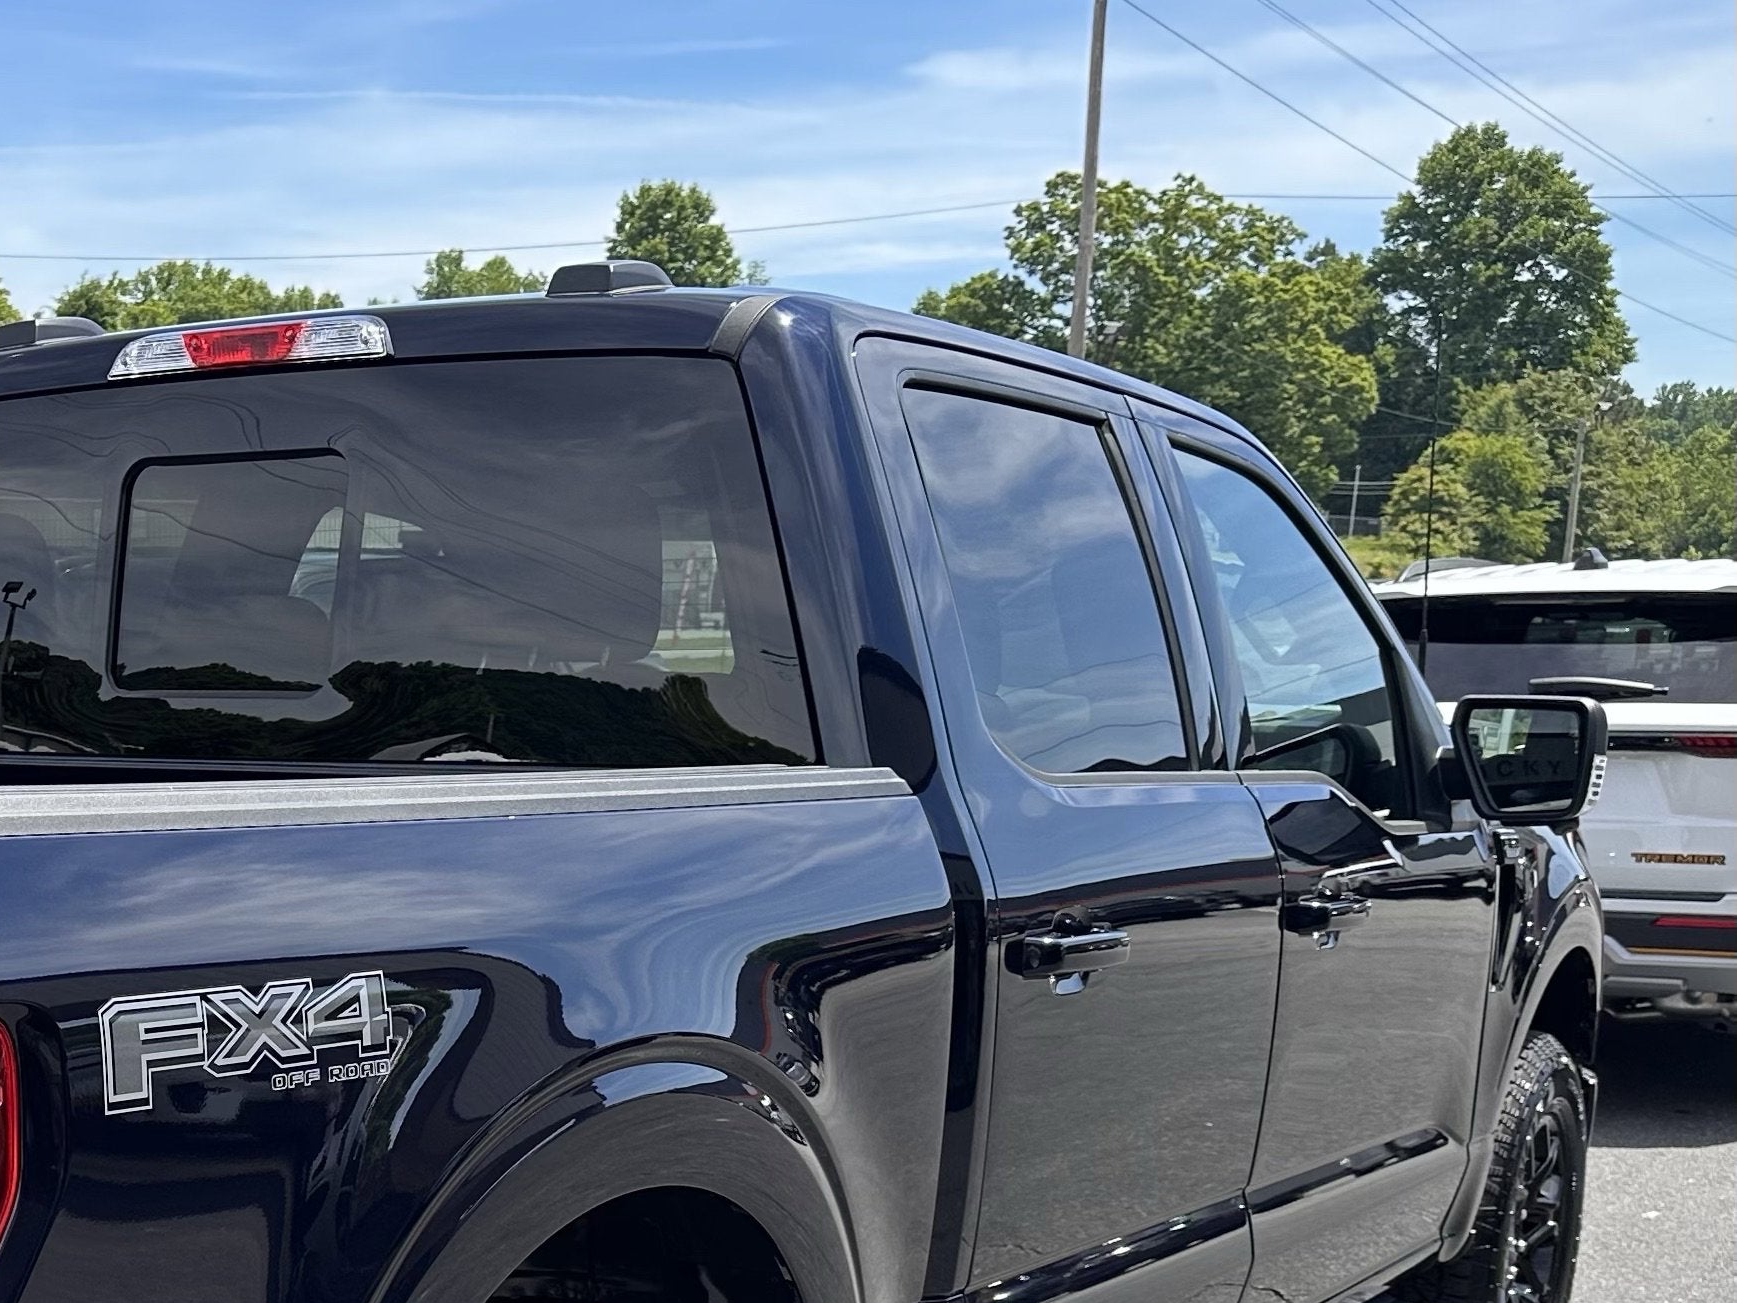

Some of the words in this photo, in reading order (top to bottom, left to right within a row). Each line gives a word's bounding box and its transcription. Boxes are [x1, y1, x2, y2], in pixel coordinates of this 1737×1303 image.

[1631, 852, 1726, 866] TREMOR
[97, 969, 394, 1116] FX4
[270, 1067, 321, 1091] OFF
[327, 1058, 391, 1084] ROAD
